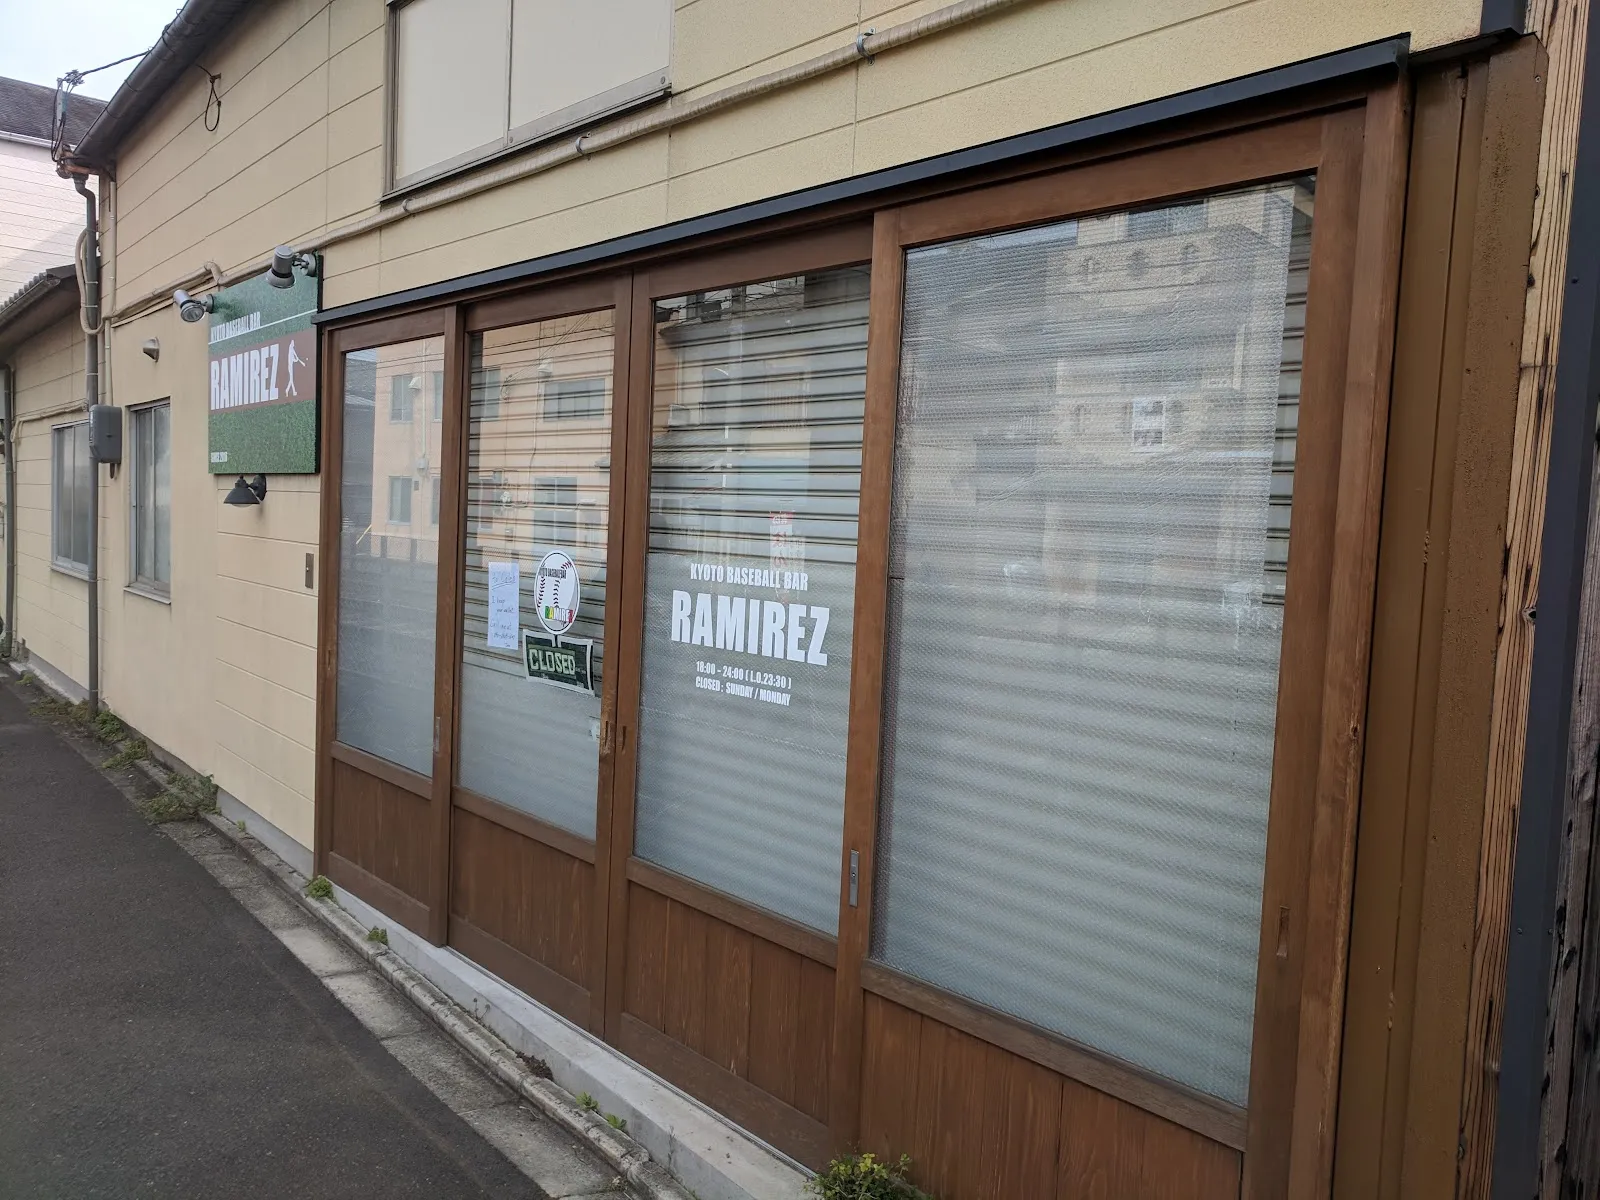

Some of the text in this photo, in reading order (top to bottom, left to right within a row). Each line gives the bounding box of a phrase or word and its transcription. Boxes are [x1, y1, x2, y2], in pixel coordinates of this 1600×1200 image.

[211, 344, 279, 410] RAMIREZ
[690, 563, 809, 591] KYOTO BASEBALL BAR
[671, 589, 830, 667] RAMIREZ
[528, 648, 576, 675] CLOSED
[696, 660, 716, 675] 18:00
[722, 665, 744, 681] 24:00
[726, 682, 754, 699] SUNDAY
[759, 688, 791, 706] MONDAY
